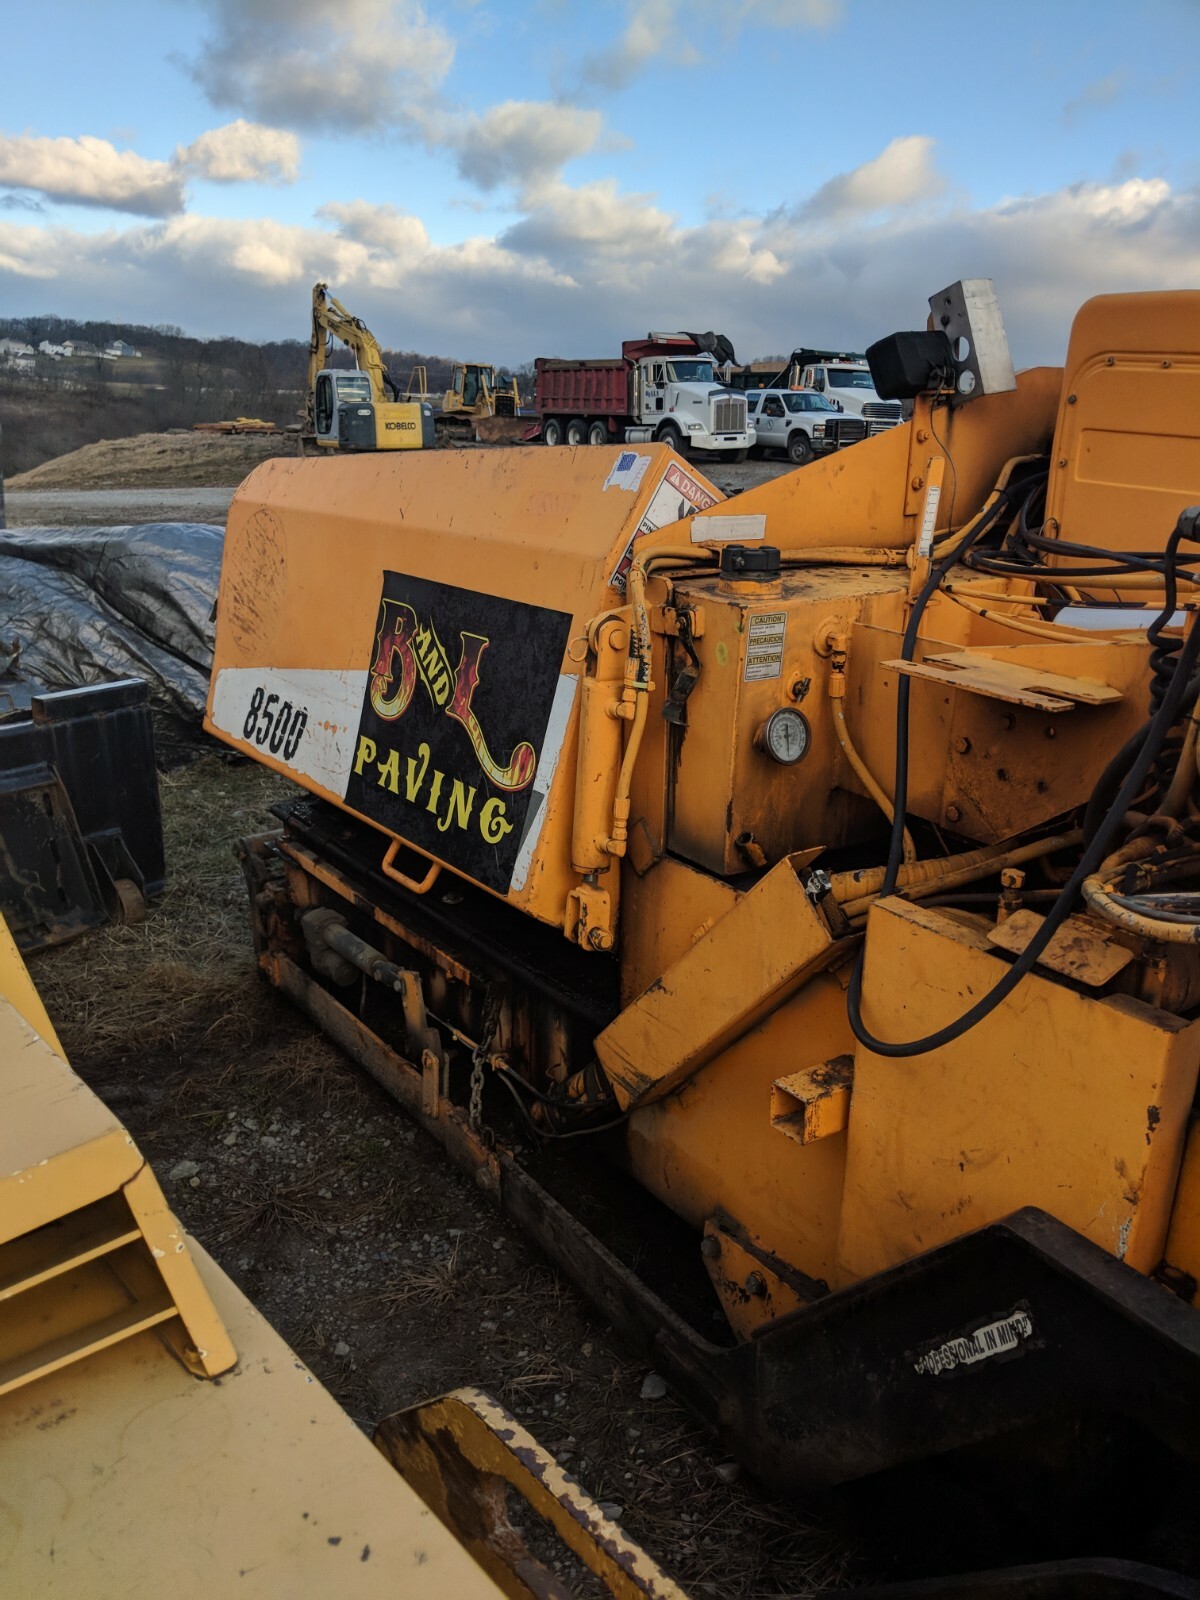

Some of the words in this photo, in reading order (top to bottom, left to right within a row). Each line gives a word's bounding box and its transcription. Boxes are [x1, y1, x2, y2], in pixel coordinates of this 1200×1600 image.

[384, 422, 417, 431] KOBELCO
[680, 480, 715, 510] DANG
[754, 615, 782, 625] CAUTION
[370, 598, 418, 722] B
[415, 622, 451, 707] AND
[748, 654, 781, 664] ATTENTION
[242, 687, 308, 761] 8500
[353, 735, 514, 844] PAVING
[983, 1329, 998, 1351] IN
